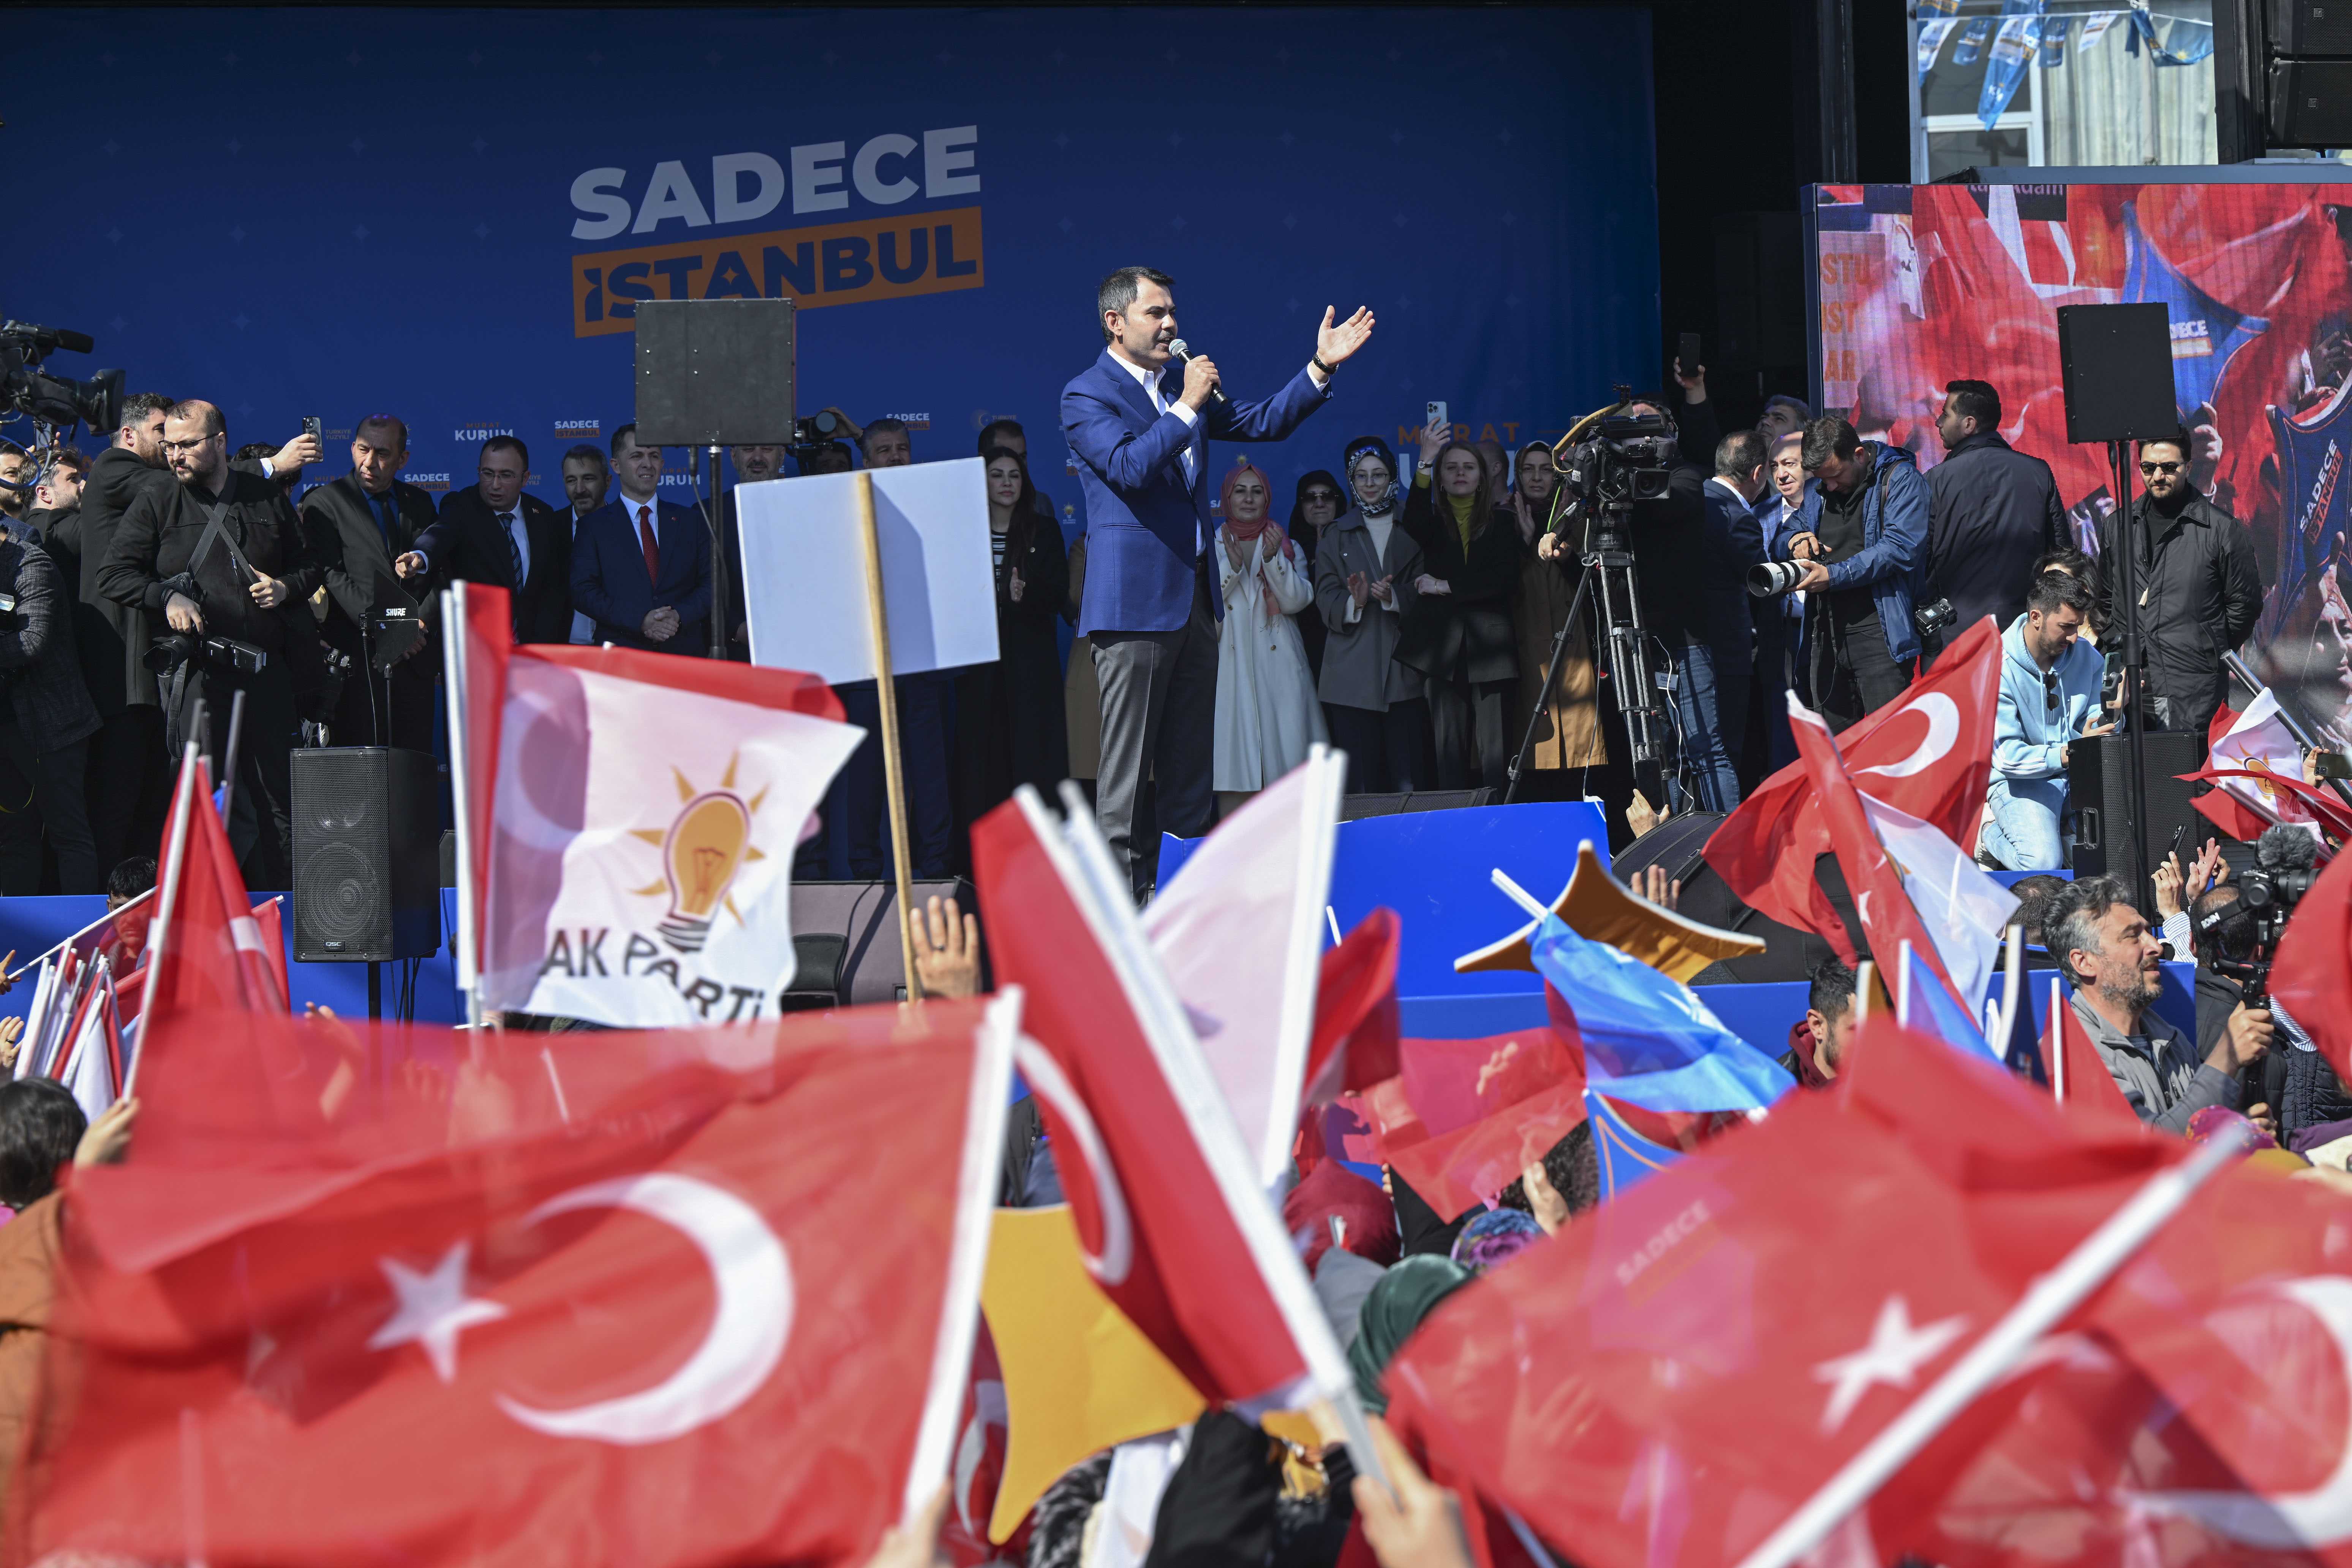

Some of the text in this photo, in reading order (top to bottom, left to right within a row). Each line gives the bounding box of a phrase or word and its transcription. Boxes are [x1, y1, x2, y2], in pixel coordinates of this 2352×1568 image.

[570, 125, 981, 240] SADECE
[555, 420, 599, 428] SADECE
[886, 413, 929, 421] SADECE
[1398, 422, 1519, 446] MRAT
[404, 473, 450, 482] SADECE
[657, 474, 700, 485] URUM
[2300, 439, 2337, 532] SADECE
[386, 608, 406, 616] SHURE
[2201, 912, 2221, 929] RONIN
[539, 927, 610, 977] AK
